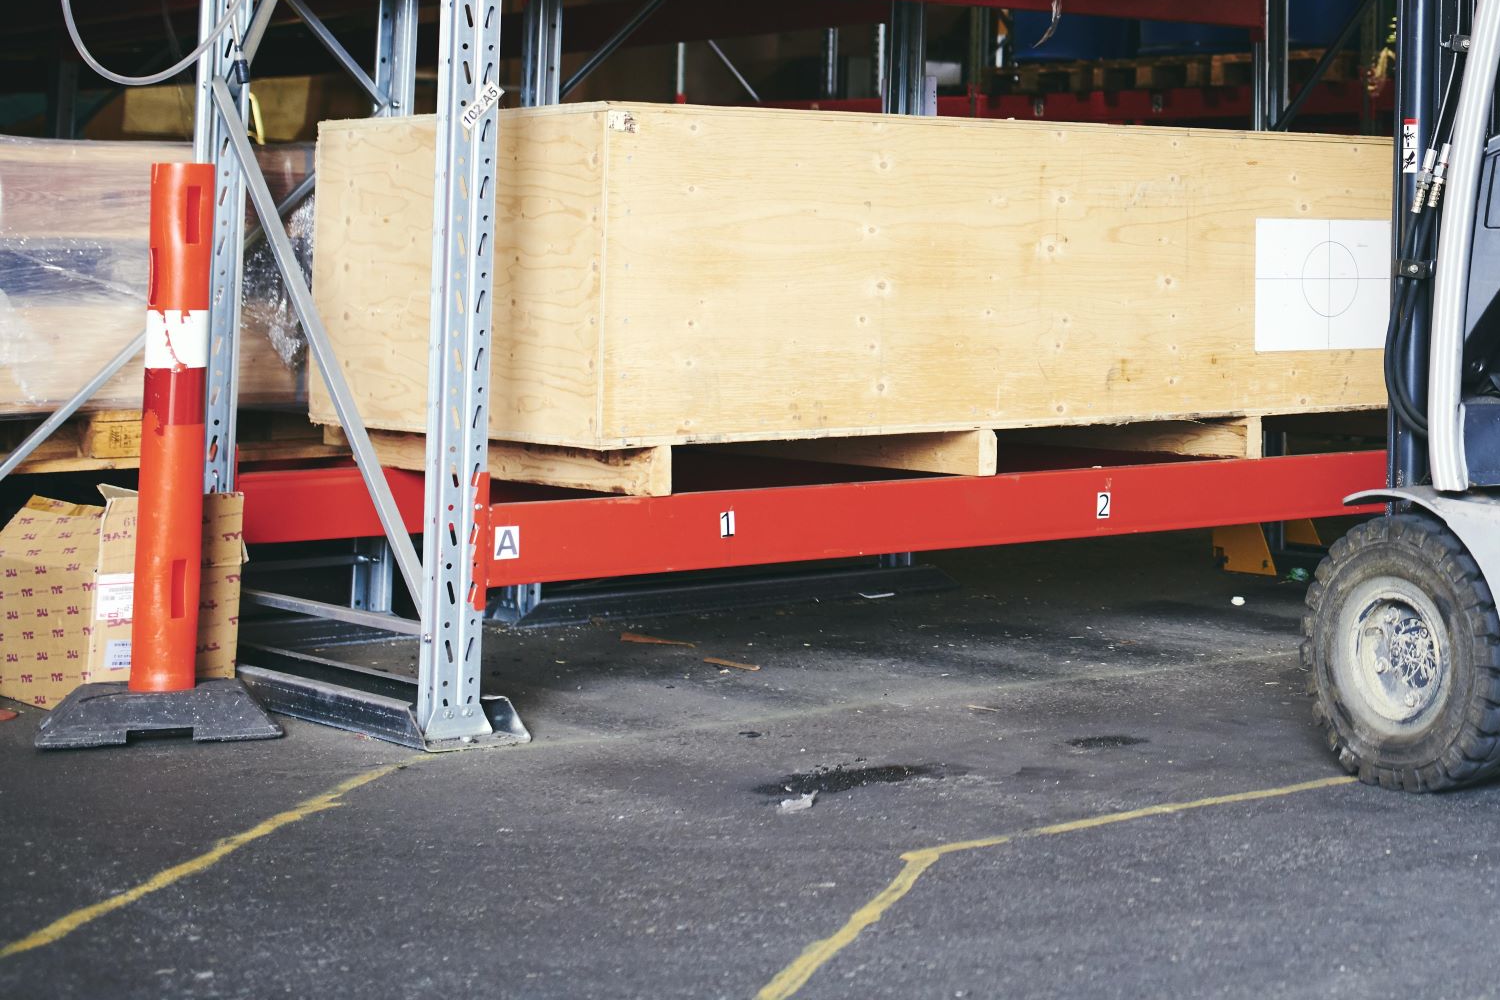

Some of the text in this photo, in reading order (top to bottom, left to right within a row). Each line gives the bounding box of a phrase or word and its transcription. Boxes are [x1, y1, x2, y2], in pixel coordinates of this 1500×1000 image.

[1098, 493, 1109, 517] 2
[721, 511, 735, 538] 1
[496, 529, 518, 556] A
[21, 588, 33, 598] TYC
[51, 585, 63, 595] TYC
[22, 629, 64, 640] TYC TYC
[21, 673, 63, 683] TYC TYC
